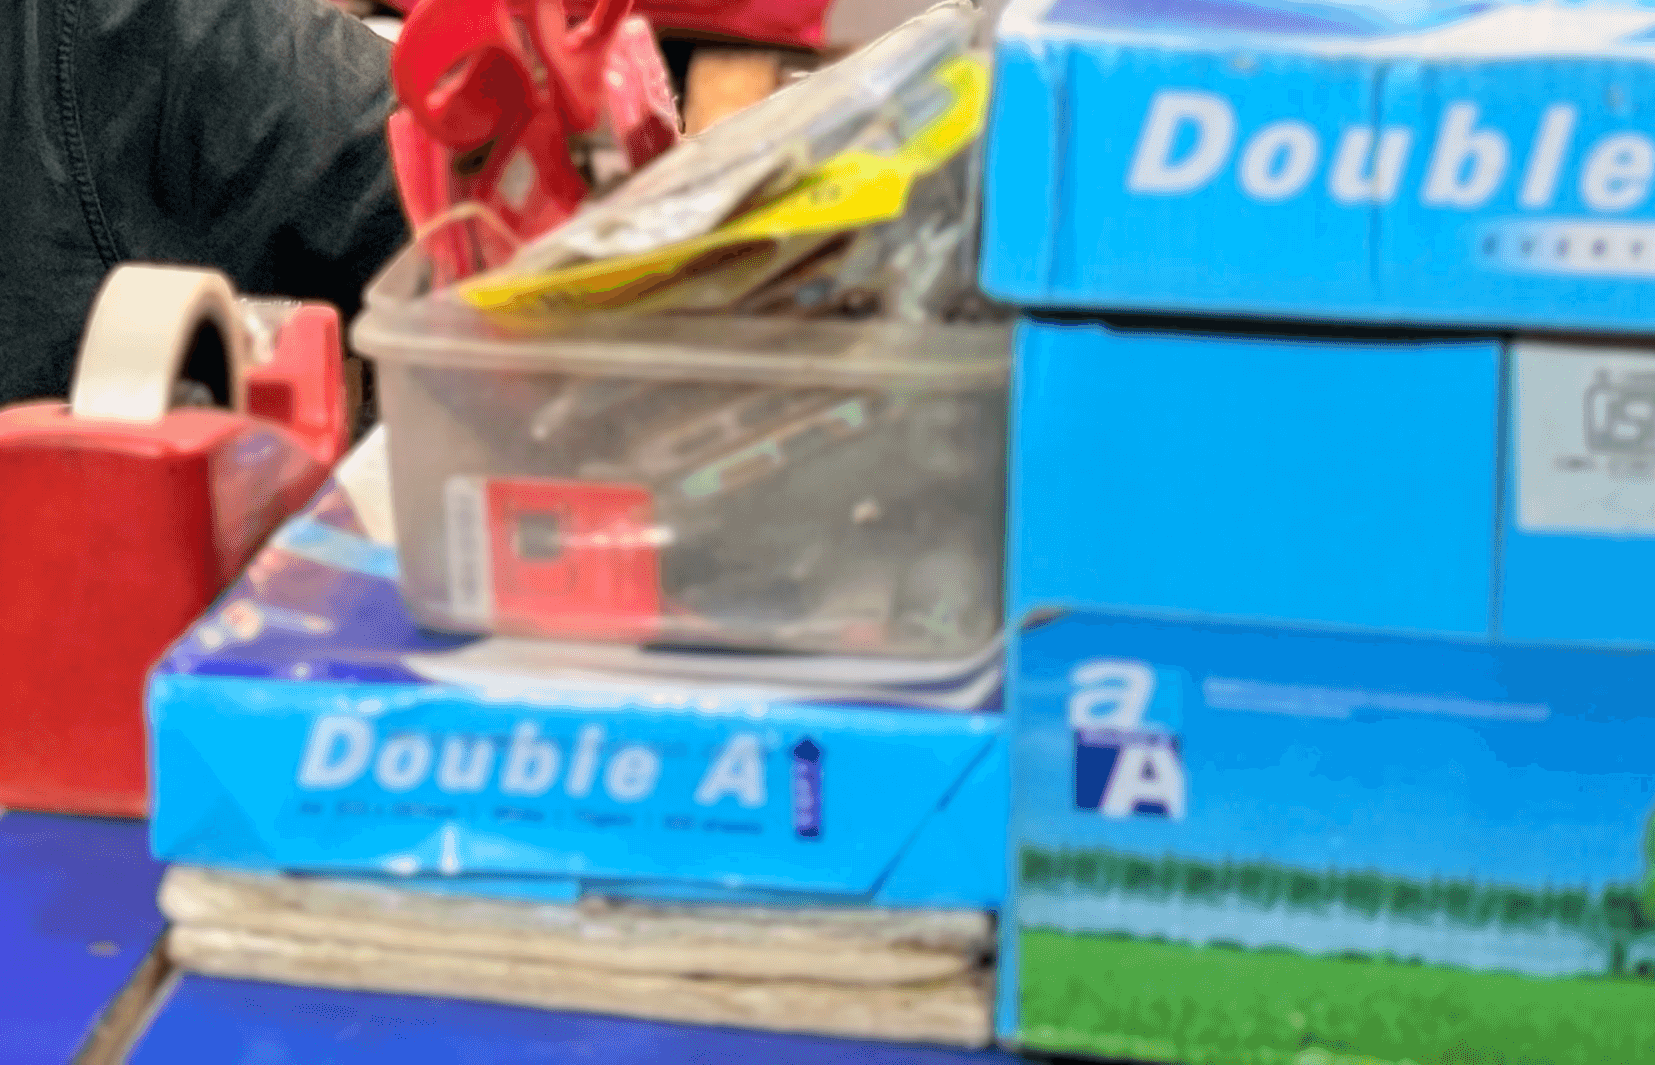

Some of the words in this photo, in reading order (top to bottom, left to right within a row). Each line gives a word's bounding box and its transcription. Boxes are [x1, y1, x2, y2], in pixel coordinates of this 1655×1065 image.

[1127, 91, 1655, 210] Double
[296, 714, 663, 803] Double
[692, 731, 768, 809] A
